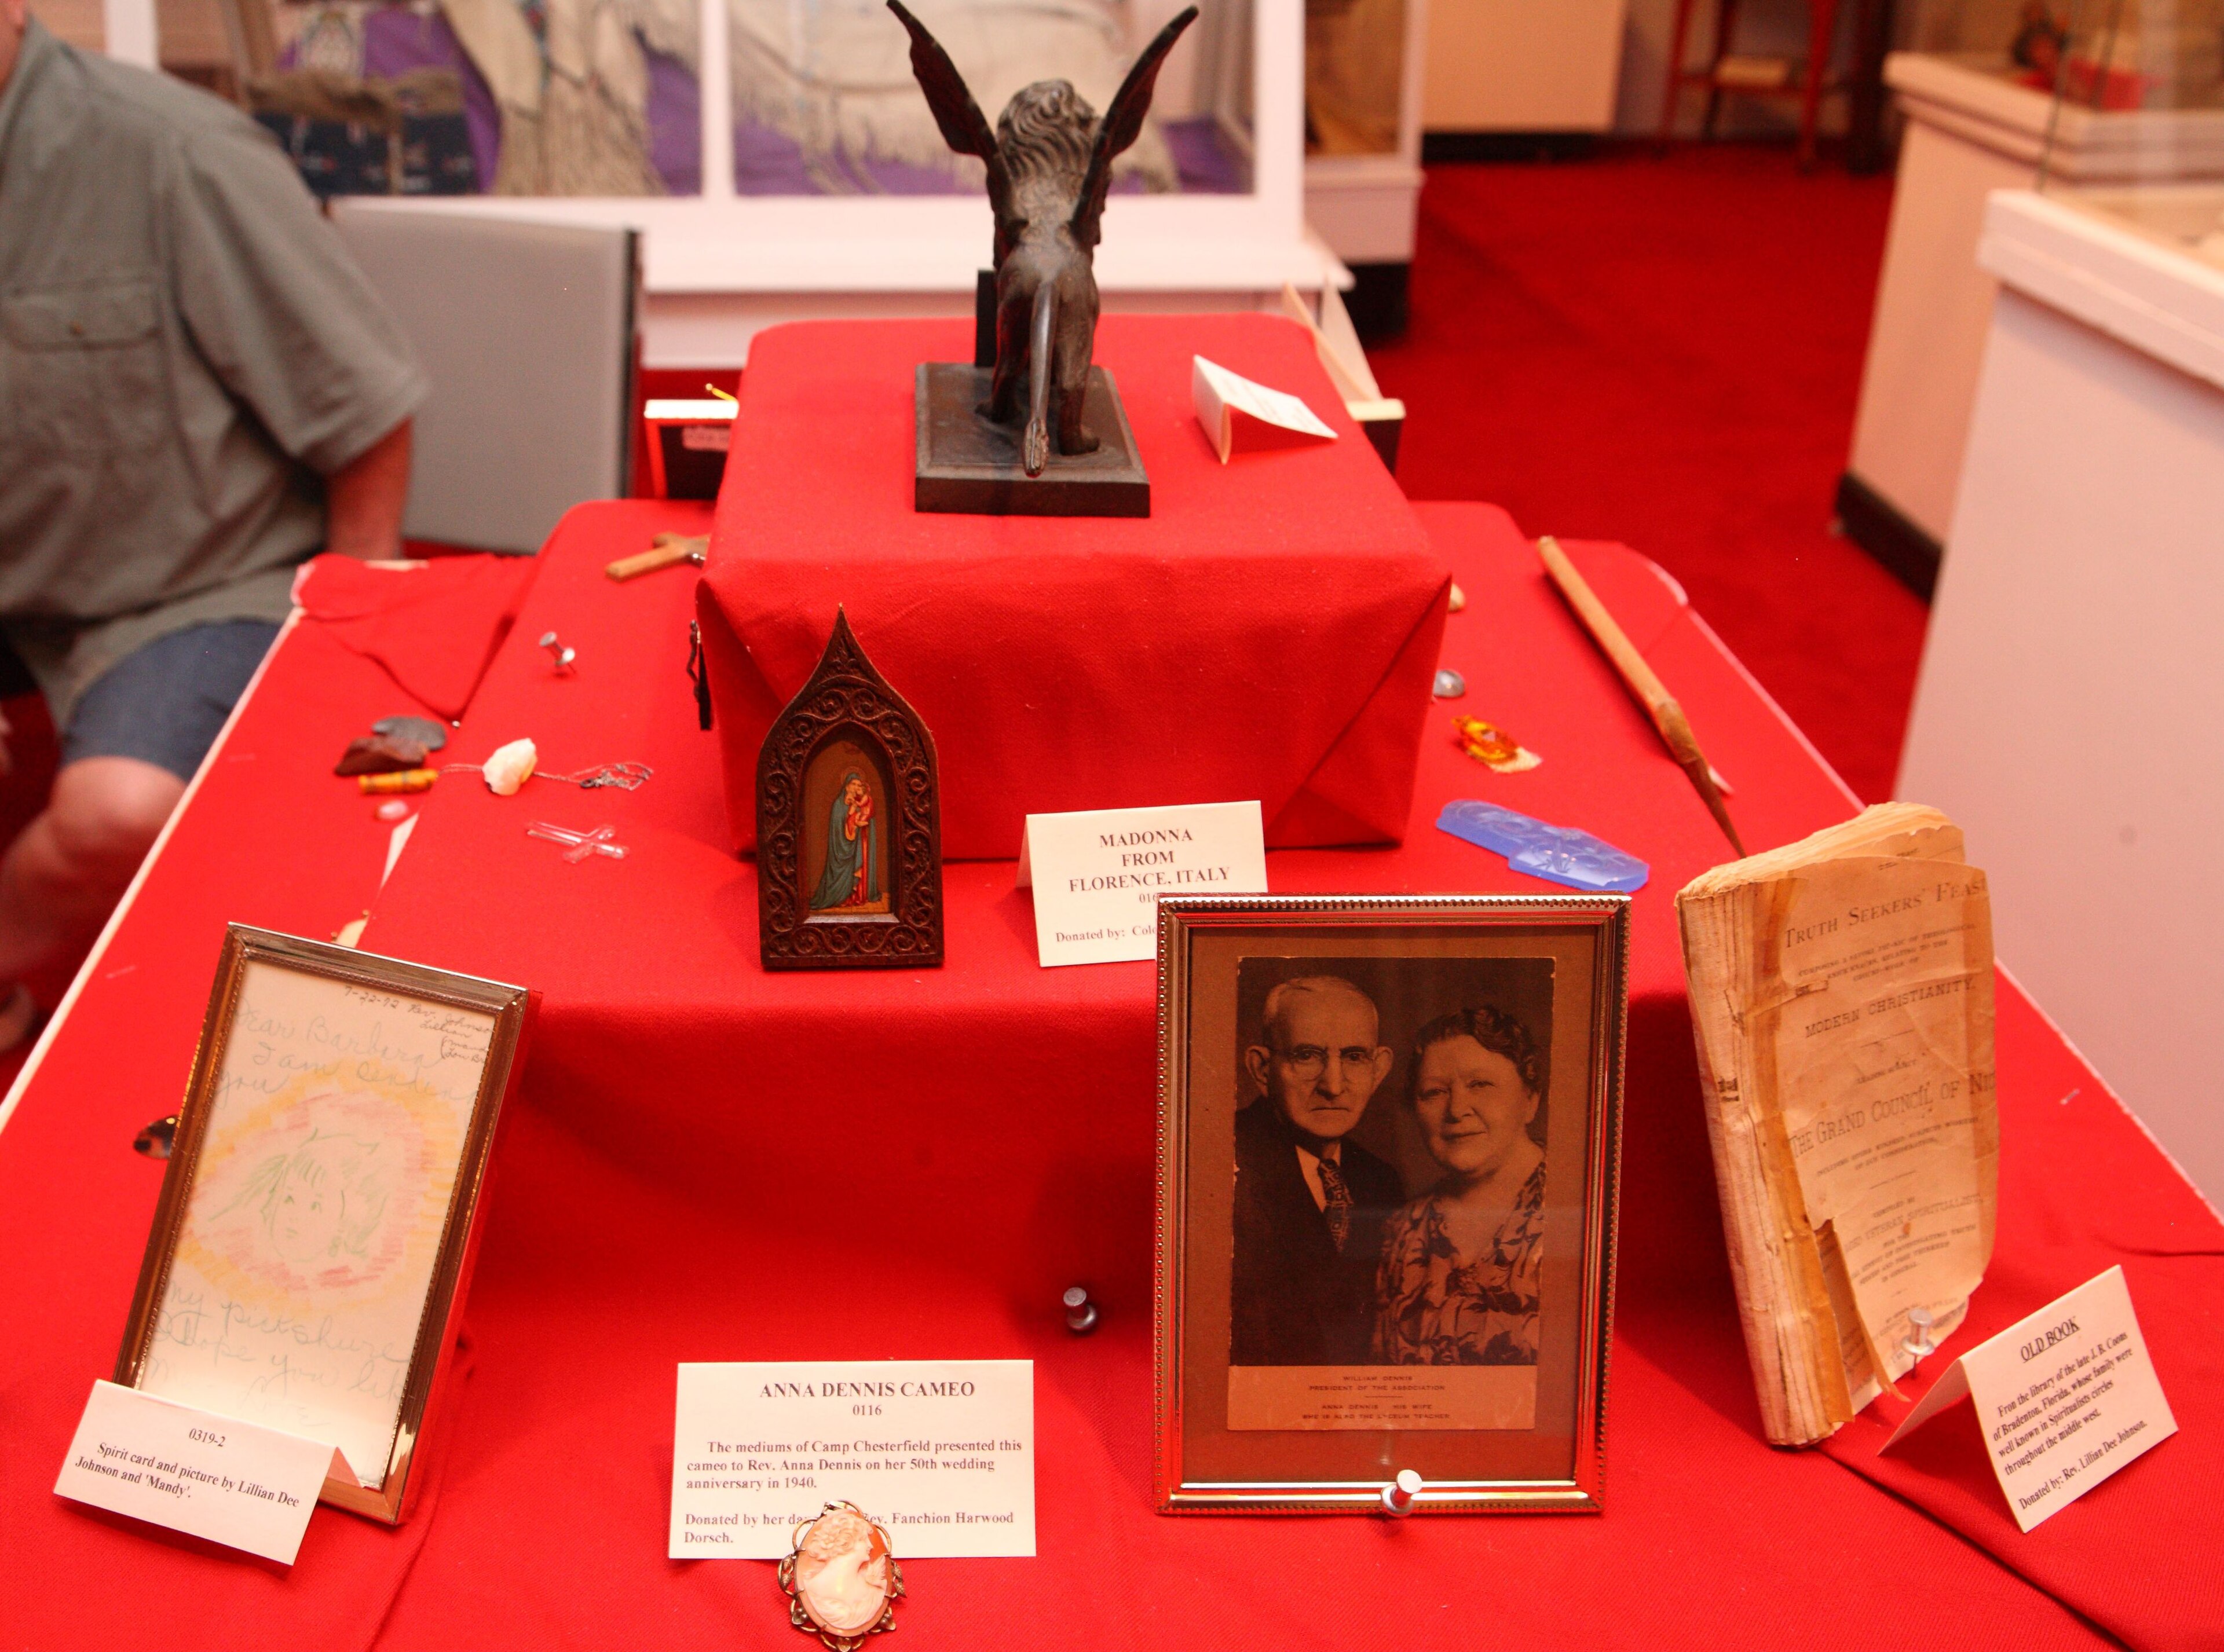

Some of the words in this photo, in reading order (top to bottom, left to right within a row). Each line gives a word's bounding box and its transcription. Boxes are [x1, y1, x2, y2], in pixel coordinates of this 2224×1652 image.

[1100, 829, 1193, 848] MADONNA
[1122, 851, 1175, 867] FROM
[1069, 873, 1171, 892] FLORENCE,
[1177, 867, 1231, 884] ITALY
[1056, 929, 1103, 943] Donated
[1107, 928, 1125, 941] by:
[1786, 918, 1838, 948] TRUTH
[1806, 1009, 1859, 1038] MODERN
[1868, 977, 1976, 1016] CHRISTIANITY
[1816, 1111, 1865, 1144] GRAND
[2021, 1337, 2044, 1361] OLD
[2046, 1316, 2080, 1346] BOOK
[760, 1383, 815, 1397] ANNA
[822, 1382, 895, 1397] DENNIS
[901, 1381, 975, 1397] CAMEO
[2018, 1393, 2029, 1406] the
[2030, 1376, 2055, 1397] library
[2057, 1368, 2064, 1382] of
[2065, 1362, 2076, 1376] the
[2076, 1354, 2090, 1368] late
[1993, 1427, 2000, 1441] of
[2071, 1374, 2093, 1391] whose
[2093, 1358, 2115, 1378] family
[2116, 1347, 2133, 1362] were
[853, 1405, 881, 1416] 0116
[1999, 1440, 2015, 1458] well
[2015, 1426, 2040, 1448] known
[2040, 1419, 2049, 1431] in
[2091, 1379, 2115, 1399] circles
[189, 1428, 226, 1448] 0319-2
[708, 1442, 731, 1453] The
[736, 1441, 792, 1453] mediums
[796, 1441, 809, 1452] of
[812, 1441, 850, 1455] Camp
[854, 1440, 930, 1452] Chesterfield
[935, 1439, 995, 1454] presented
[1000, 1439, 1022, 1452] this
[2004, 1443, 2046, 1475] throughout
[2046, 1434, 2058, 1449] the
[2058, 1419, 2083, 1440] middle
[75, 1455, 119, 1478] Johnson
[120, 1468, 141, 1484] and
[145, 1474, 192, 1499] 'Mandy'.
[97, 1442, 129, 1460] Spirit
[130, 1450, 154, 1467] card
[156, 1457, 178, 1474] and
[178, 1465, 219, 1486] picture
[221, 1475, 236, 1492] by
[238, 1479, 275, 1501] Lillian
[277, 1491, 300, 1508] Dee
[687, 1461, 727, 1471] cameo
[731, 1460, 744, 1471] to
[748, 1460, 776, 1471] Rev.
[780, 1460, 814, 1471] Anna
[818, 1459, 862, 1471] Dennis
[866, 1462, 881, 1470] on
[885, 1459, 907, 1470] her
[910, 1458, 937, 1470] 50th
[942, 1457, 995, 1472] wedding
[2018, 1481, 2051, 1510] Donated
[2062, 1464, 2081, 1481] Rev.
[2079, 1448, 2104, 1469] Lillian
[2103, 1439, 2118, 1453] Dee
[686, 1478, 764, 1491] anniversary
[767, 1478, 780, 1488] in
[785, 1477, 817, 1489] 1940.
[685, 1514, 738, 1526] Donated
[743, 1514, 759, 1528] by
[763, 1513, 785, 1525] her
[892, 1512, 952, 1524] Fanchion
[956, 1512, 1014, 1524] Harwood
[684, 1532, 734, 1544] Dorsch.
